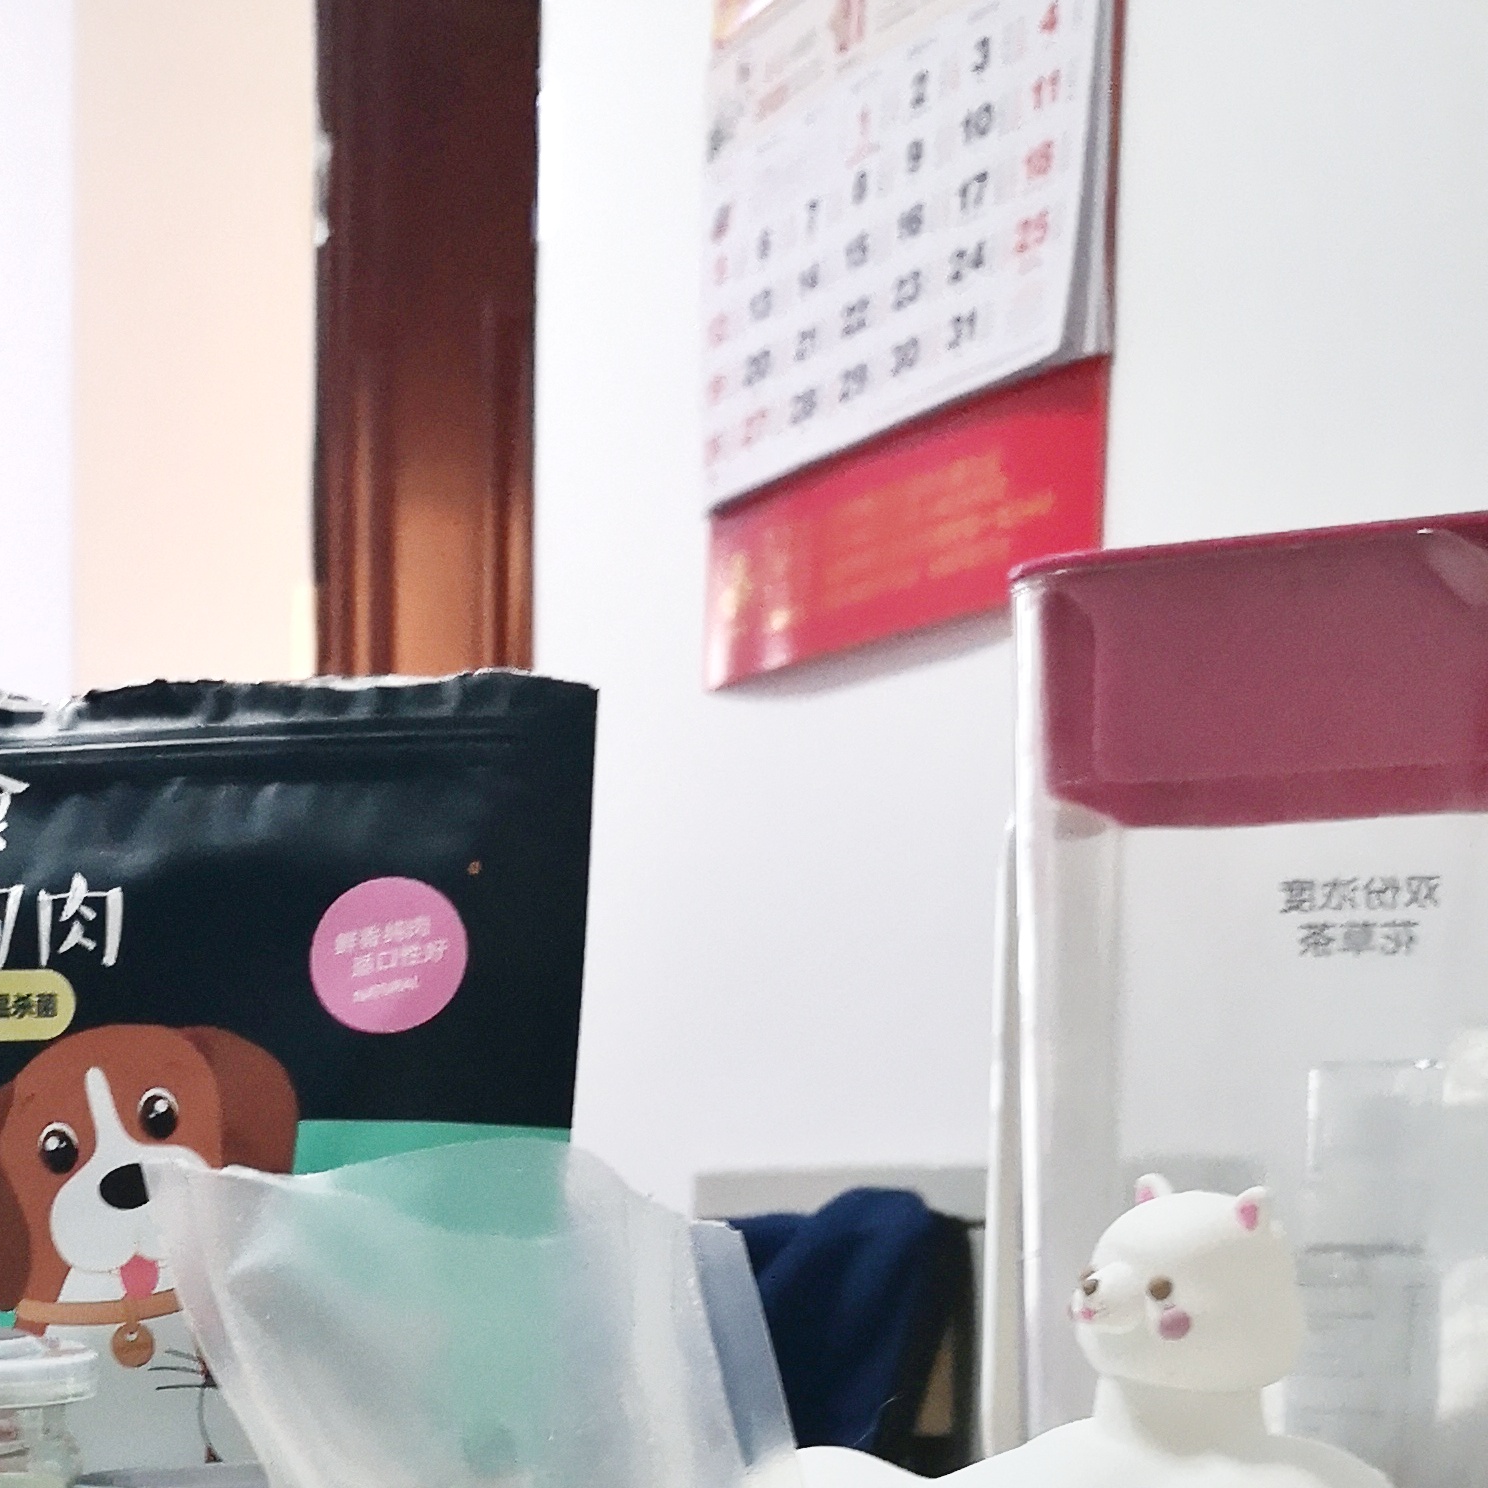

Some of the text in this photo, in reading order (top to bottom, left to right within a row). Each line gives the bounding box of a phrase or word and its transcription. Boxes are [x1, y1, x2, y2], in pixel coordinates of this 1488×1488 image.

[972, 37, 990, 74] 3
[1040, 1, 1059, 34] 4
[961, 103, 994, 142] 10
[1032, 69, 1061, 109] 11
[959, 171, 989, 210] 17
[841, 297, 870, 338] 22
[892, 269, 923, 311] 23
[949, 242, 984, 284] 24
[1013, 209, 1049, 255] 25
[948, 309, 977, 350] 31
